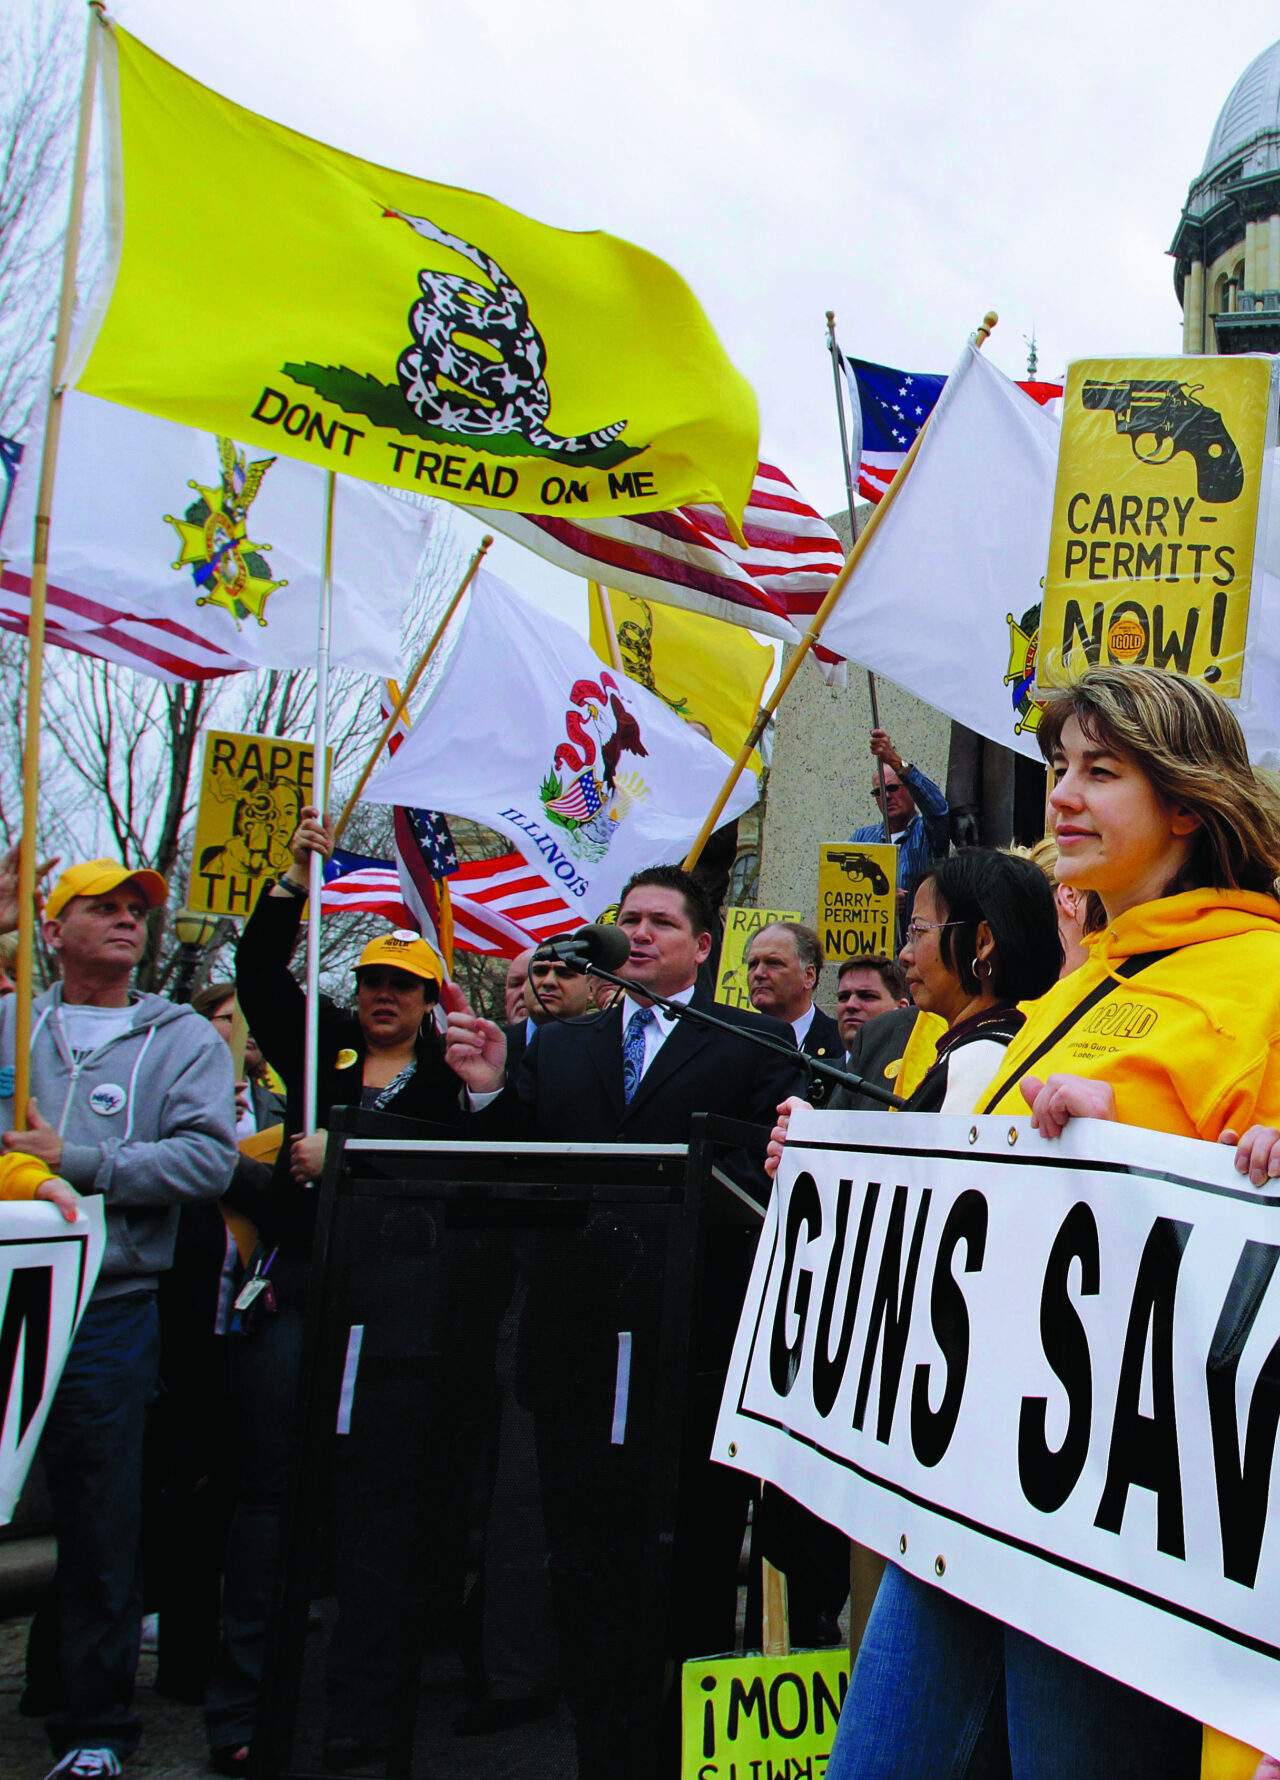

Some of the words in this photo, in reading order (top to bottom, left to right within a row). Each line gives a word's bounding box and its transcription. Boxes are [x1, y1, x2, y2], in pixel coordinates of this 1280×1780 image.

[251, 386, 365, 457] DONT
[388, 442, 519, 499] TREAD
[540, 476, 590, 505] ON
[608, 471, 658, 500] ME
[1066, 490, 1220, 537] CARRY-
[1064, 540, 1236, 587] PERMITS
[1061, 591, 1229, 684] NOW!
[1111, 633, 1143, 650] IGOLD
[212, 738, 314, 789] RAPE
[497, 808, 589, 898] ILLINOIS
[199, 872, 251, 913] TH
[824, 891, 881, 907] CARRY-
[824, 908, 889, 925] PERMITS
[825, 926, 887, 956] NOW!
[722, 985, 751, 1009] TH
[768, 1170, 990, 1468] GUNS
